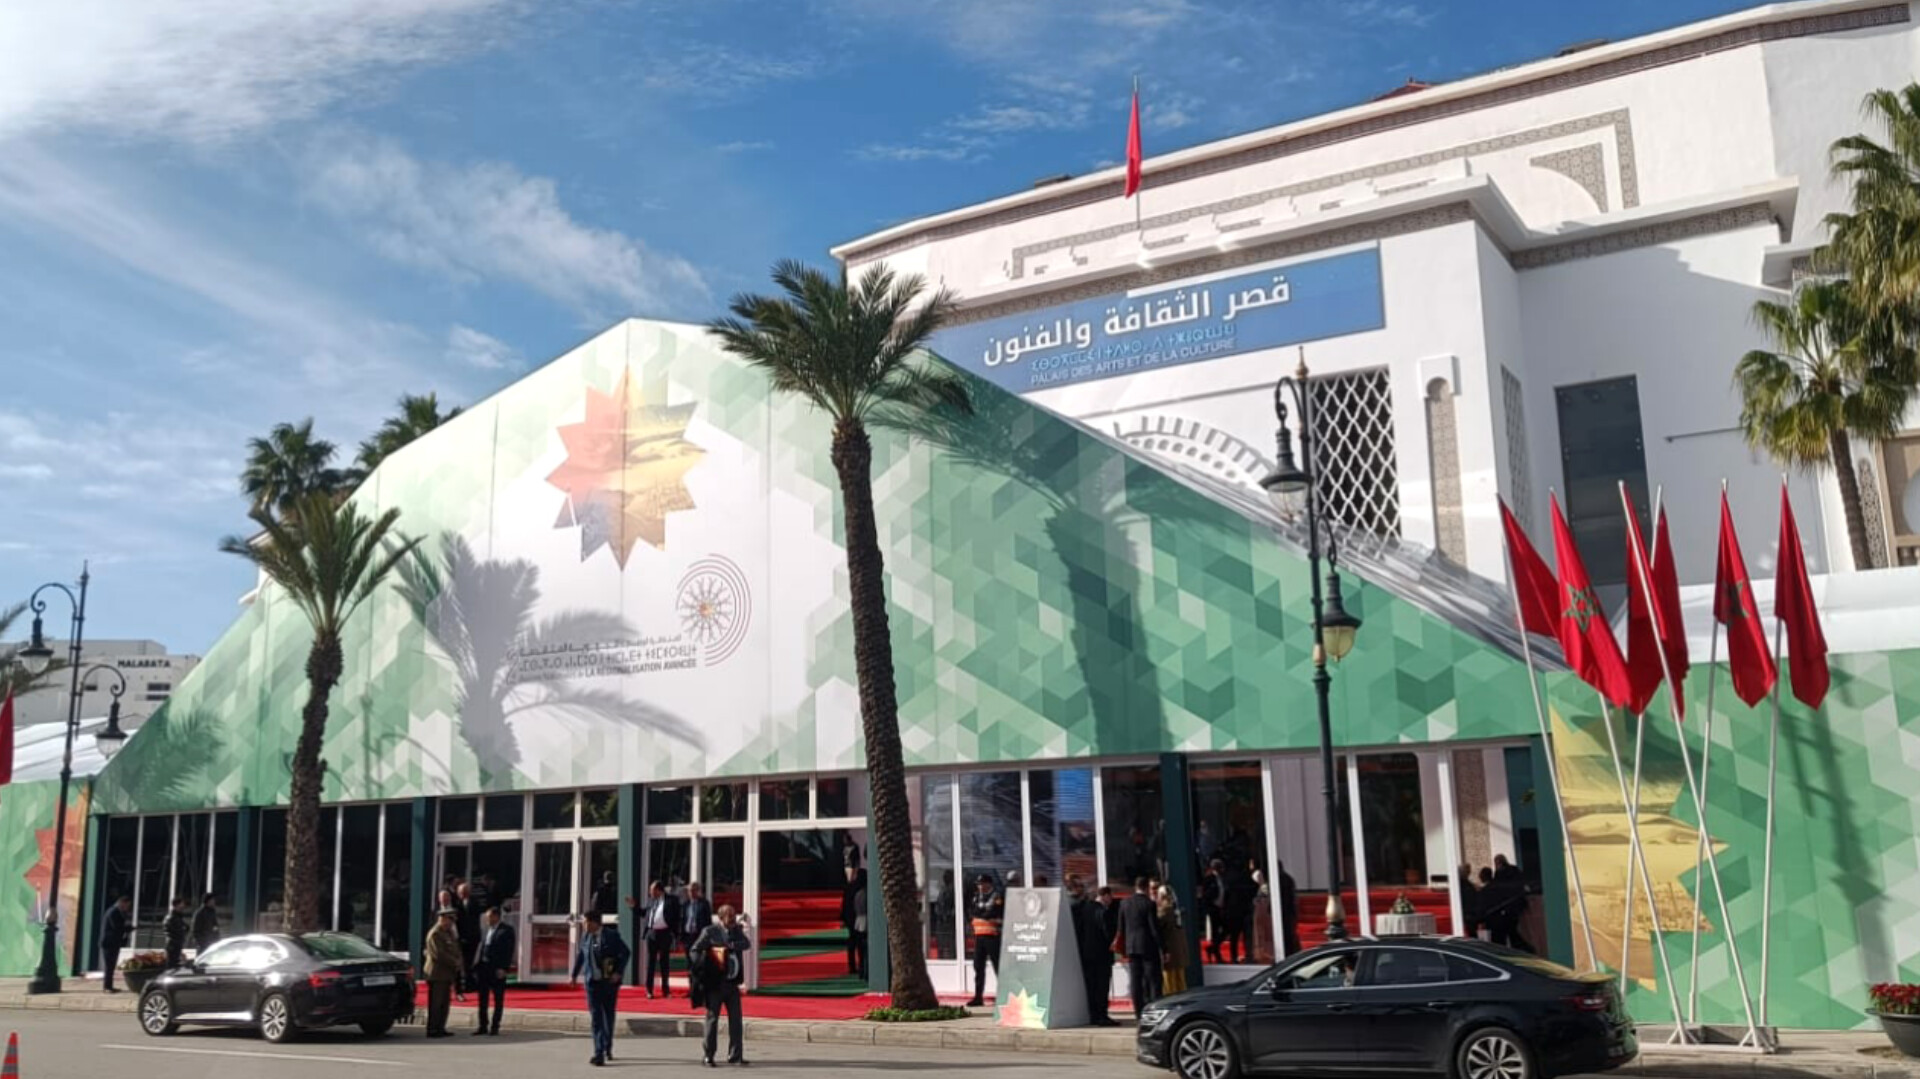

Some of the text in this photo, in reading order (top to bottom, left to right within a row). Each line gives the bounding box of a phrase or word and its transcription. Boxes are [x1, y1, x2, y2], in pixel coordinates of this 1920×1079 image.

[984, 275, 1290, 367] قصر الثقافة والفنون
[1031, 338, 1235, 385] PALAIS DES ARTS ET DE LA CULTURE
[117, 659, 171, 669] MALABATA
